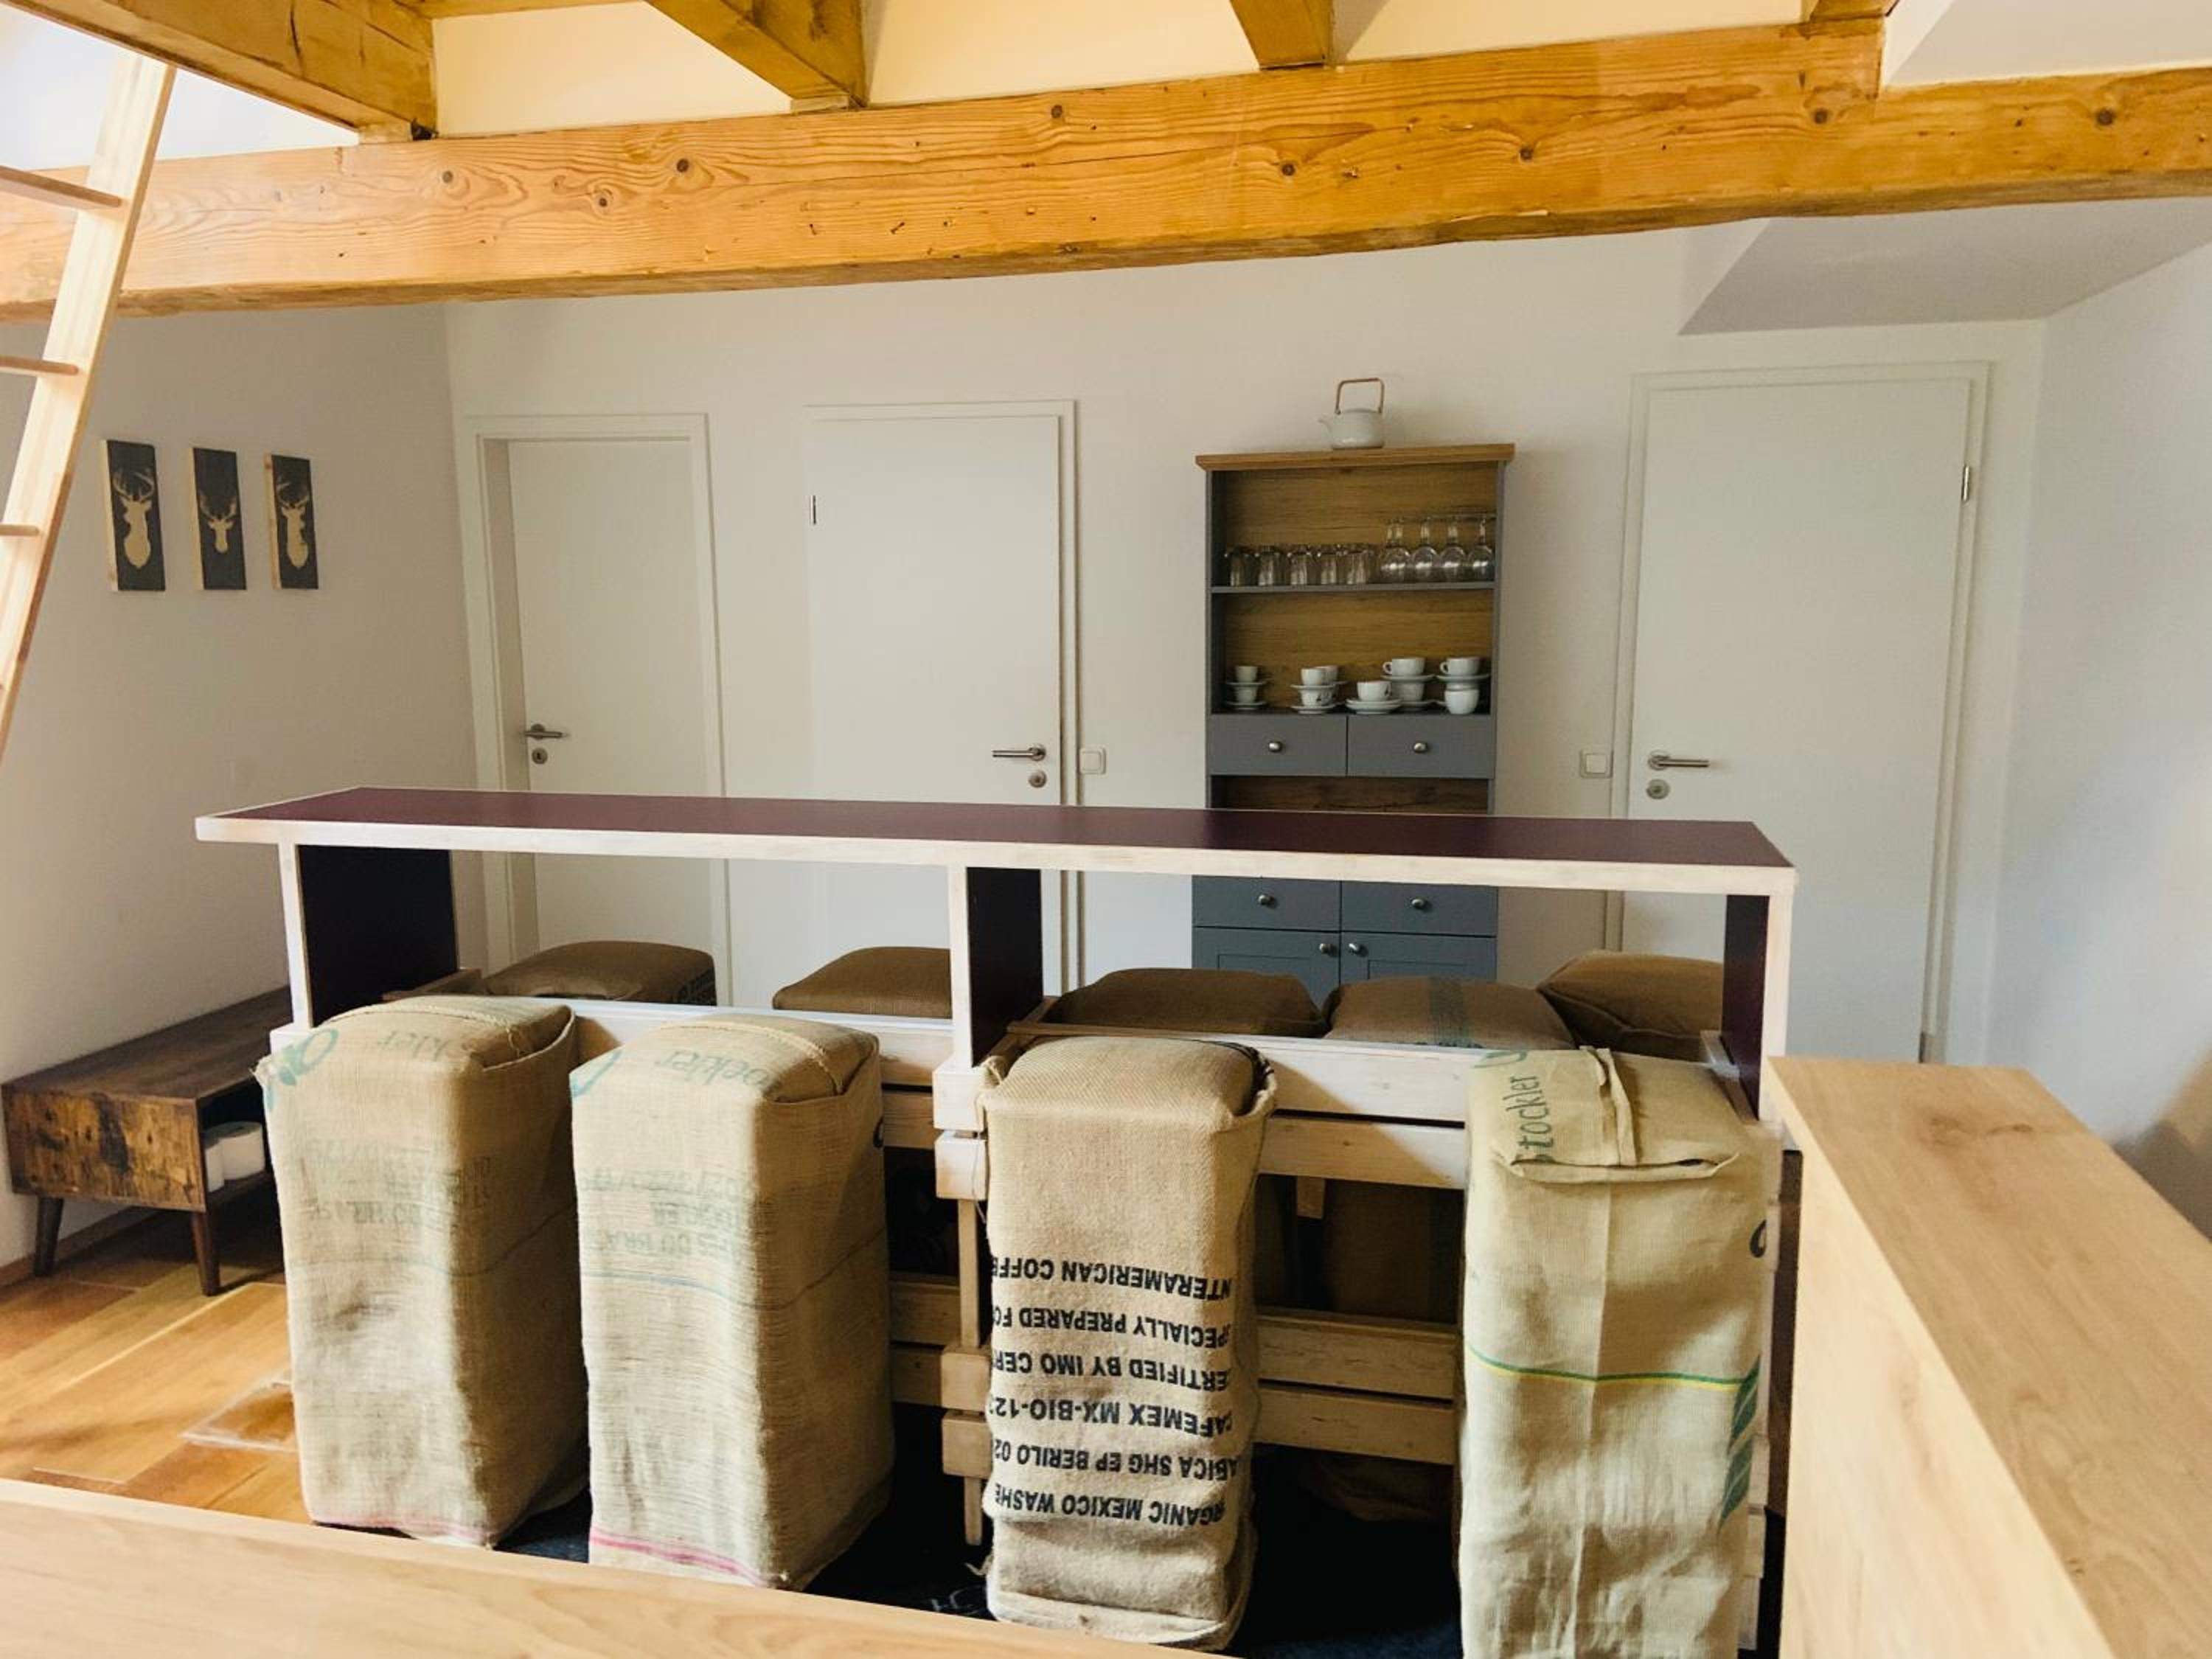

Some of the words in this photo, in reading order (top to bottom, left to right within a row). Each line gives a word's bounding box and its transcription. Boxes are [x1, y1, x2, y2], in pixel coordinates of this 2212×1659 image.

[1019, 1307, 1126, 1333] PREPARED
[1133, 1315, 1231, 1349] PECIALLY
[1040, 1353, 1084, 1376] IMO
[1091, 1356, 1121, 1377] BY
[1017, 1444, 1089, 1470] BERILO
[1096, 1452, 1121, 1472] EP
[1128, 1453, 1172, 1476] SHG
[1062, 1495, 1144, 1520] MEXICO
